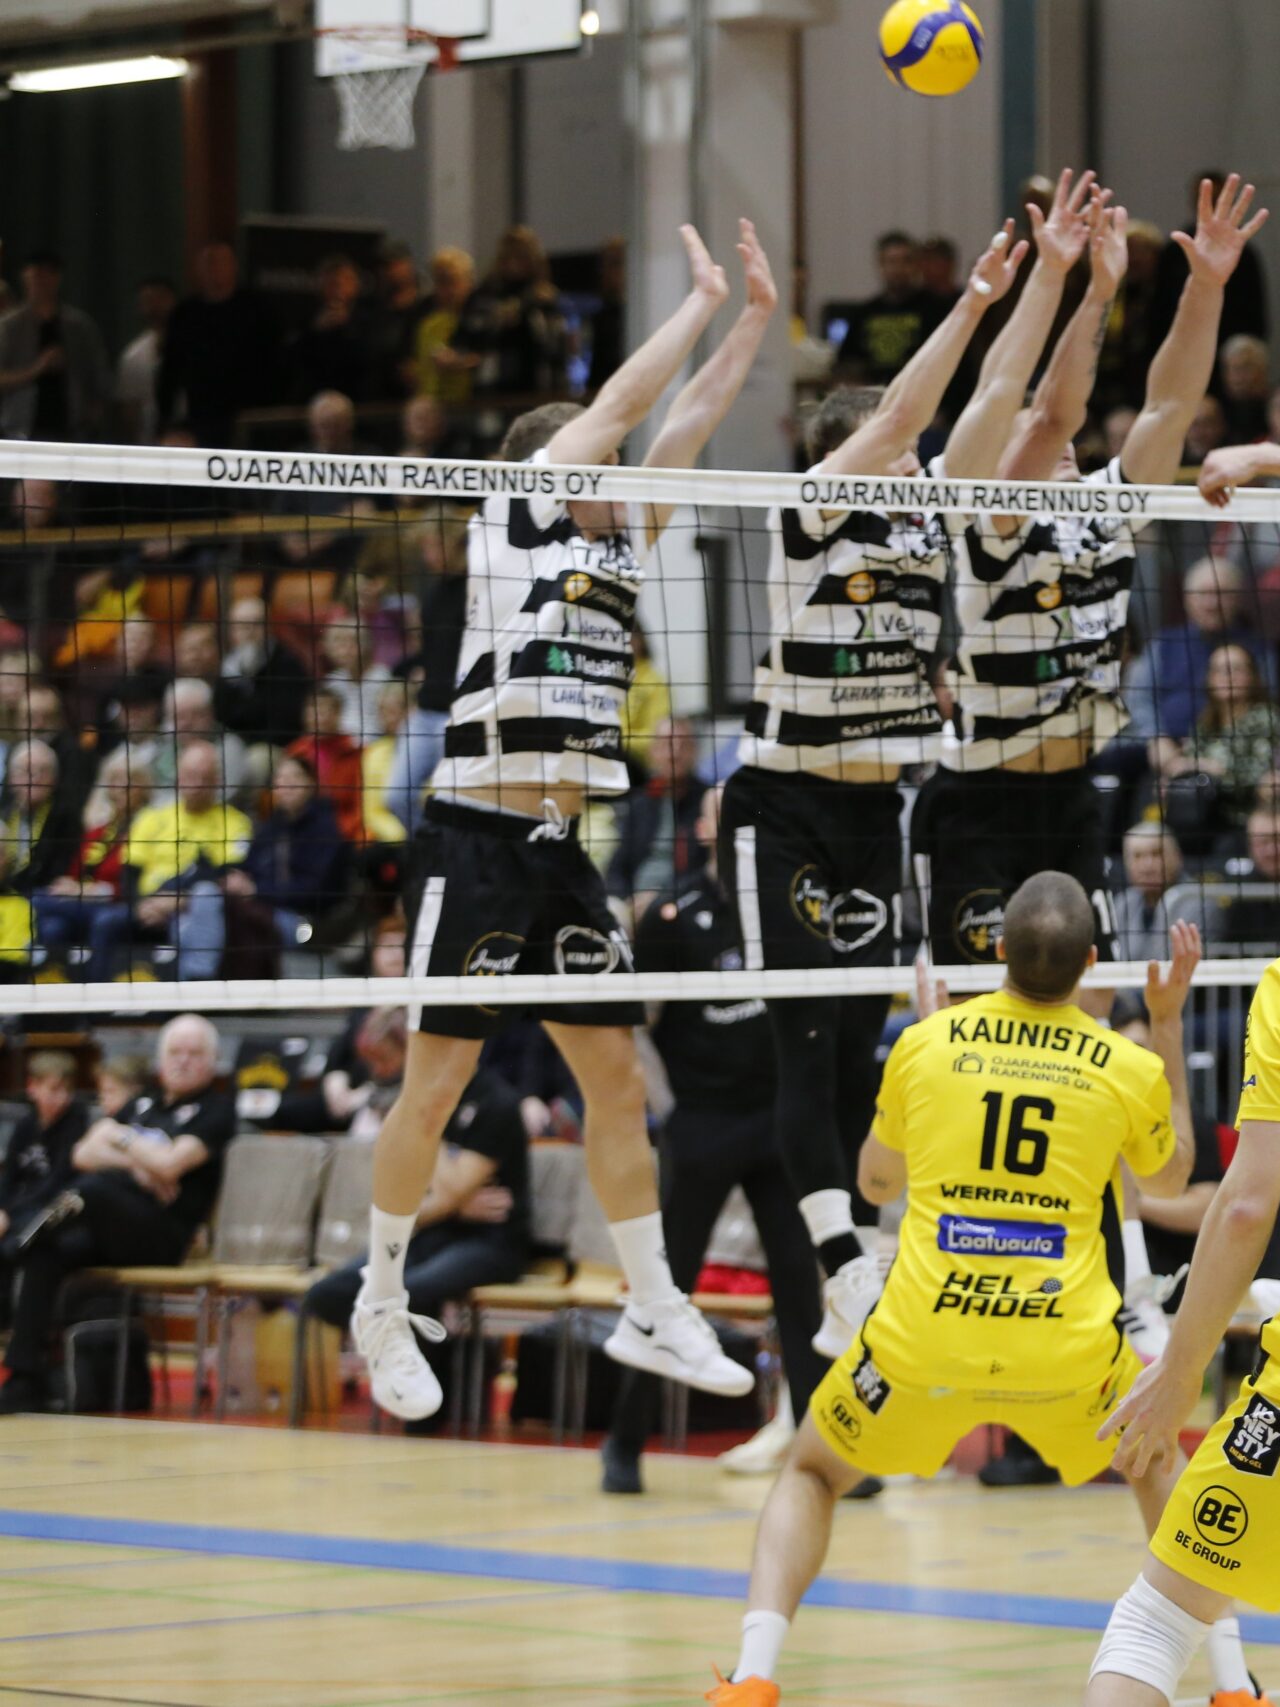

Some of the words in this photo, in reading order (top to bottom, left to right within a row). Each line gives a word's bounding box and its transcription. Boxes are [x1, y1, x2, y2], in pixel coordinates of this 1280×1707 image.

[207, 455, 387, 487] OJARANNAN
[401, 464, 555, 494] RAKENNUS
[565, 472, 603, 495] OY
[800, 480, 960, 507] OJARANNAN
[972, 486, 1109, 512] RAKENNUS
[1117, 491, 1151, 513] OY
[949, 1016, 1113, 1068] KAUNISTO
[989, 1066, 1070, 1086] RAKENNUS
[1073, 1078, 1093, 1092] OY
[991, 1055, 1082, 1075] OJARANNAN
[978, 1090, 1056, 1177] 16
[940, 1183, 1070, 1211] WERRATON
[947, 1226, 1054, 1254] Laatuauto
[943, 1271, 1020, 1296] HEL
[932, 1292, 1065, 1319] PADEL
[1234, 1428, 1272, 1460] STY
[1197, 1496, 1242, 1535] BE
[1174, 1529, 1192, 1549] BE
[1192, 1541, 1242, 1571] GROUP
